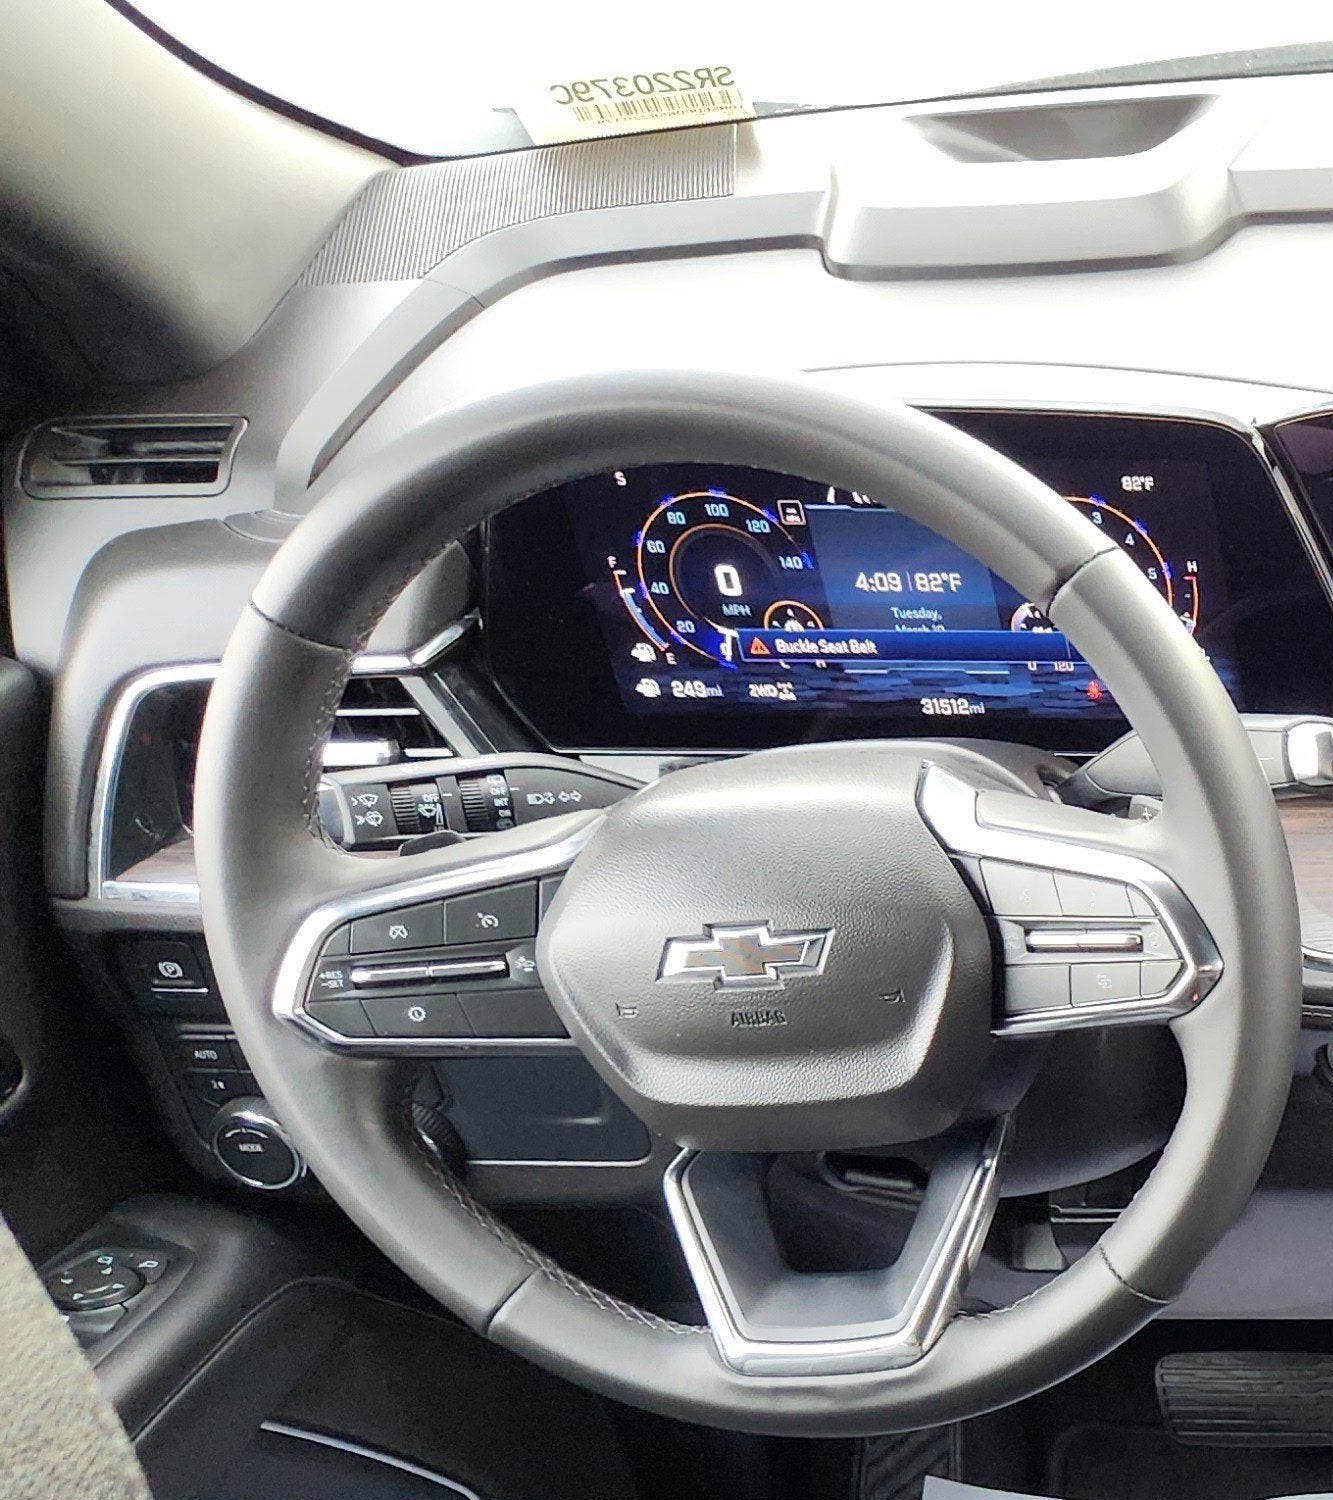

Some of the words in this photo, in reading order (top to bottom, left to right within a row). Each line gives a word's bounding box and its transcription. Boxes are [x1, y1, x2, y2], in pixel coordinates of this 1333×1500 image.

[615, 471, 627, 486] S
[704, 504, 729, 518] 100
[1091, 512, 1102, 524] 3
[667, 512, 686, 525] 80
[746, 519, 771, 533] 120
[646, 540, 665, 553] 60
[1125, 533, 1135, 546] 4
[607, 555, 617, 568] F
[779, 556, 803, 570] 140
[1186, 560, 1197, 572] H
[713, 563, 743, 597] 0
[1147, 567, 1157, 580] 5
[650, 581, 669, 595] 40
[855, 572, 901, 592] 4:09
[914, 572, 962, 592] 82°F
[721, 604, 751, 617] MPH
[676, 620, 696, 634] 20
[775, 638, 818, 654] Buckle
[819, 640, 849, 654] Seat
[850, 639, 878, 655] Belt
[730, 1009, 787, 1027] AIRBAG
